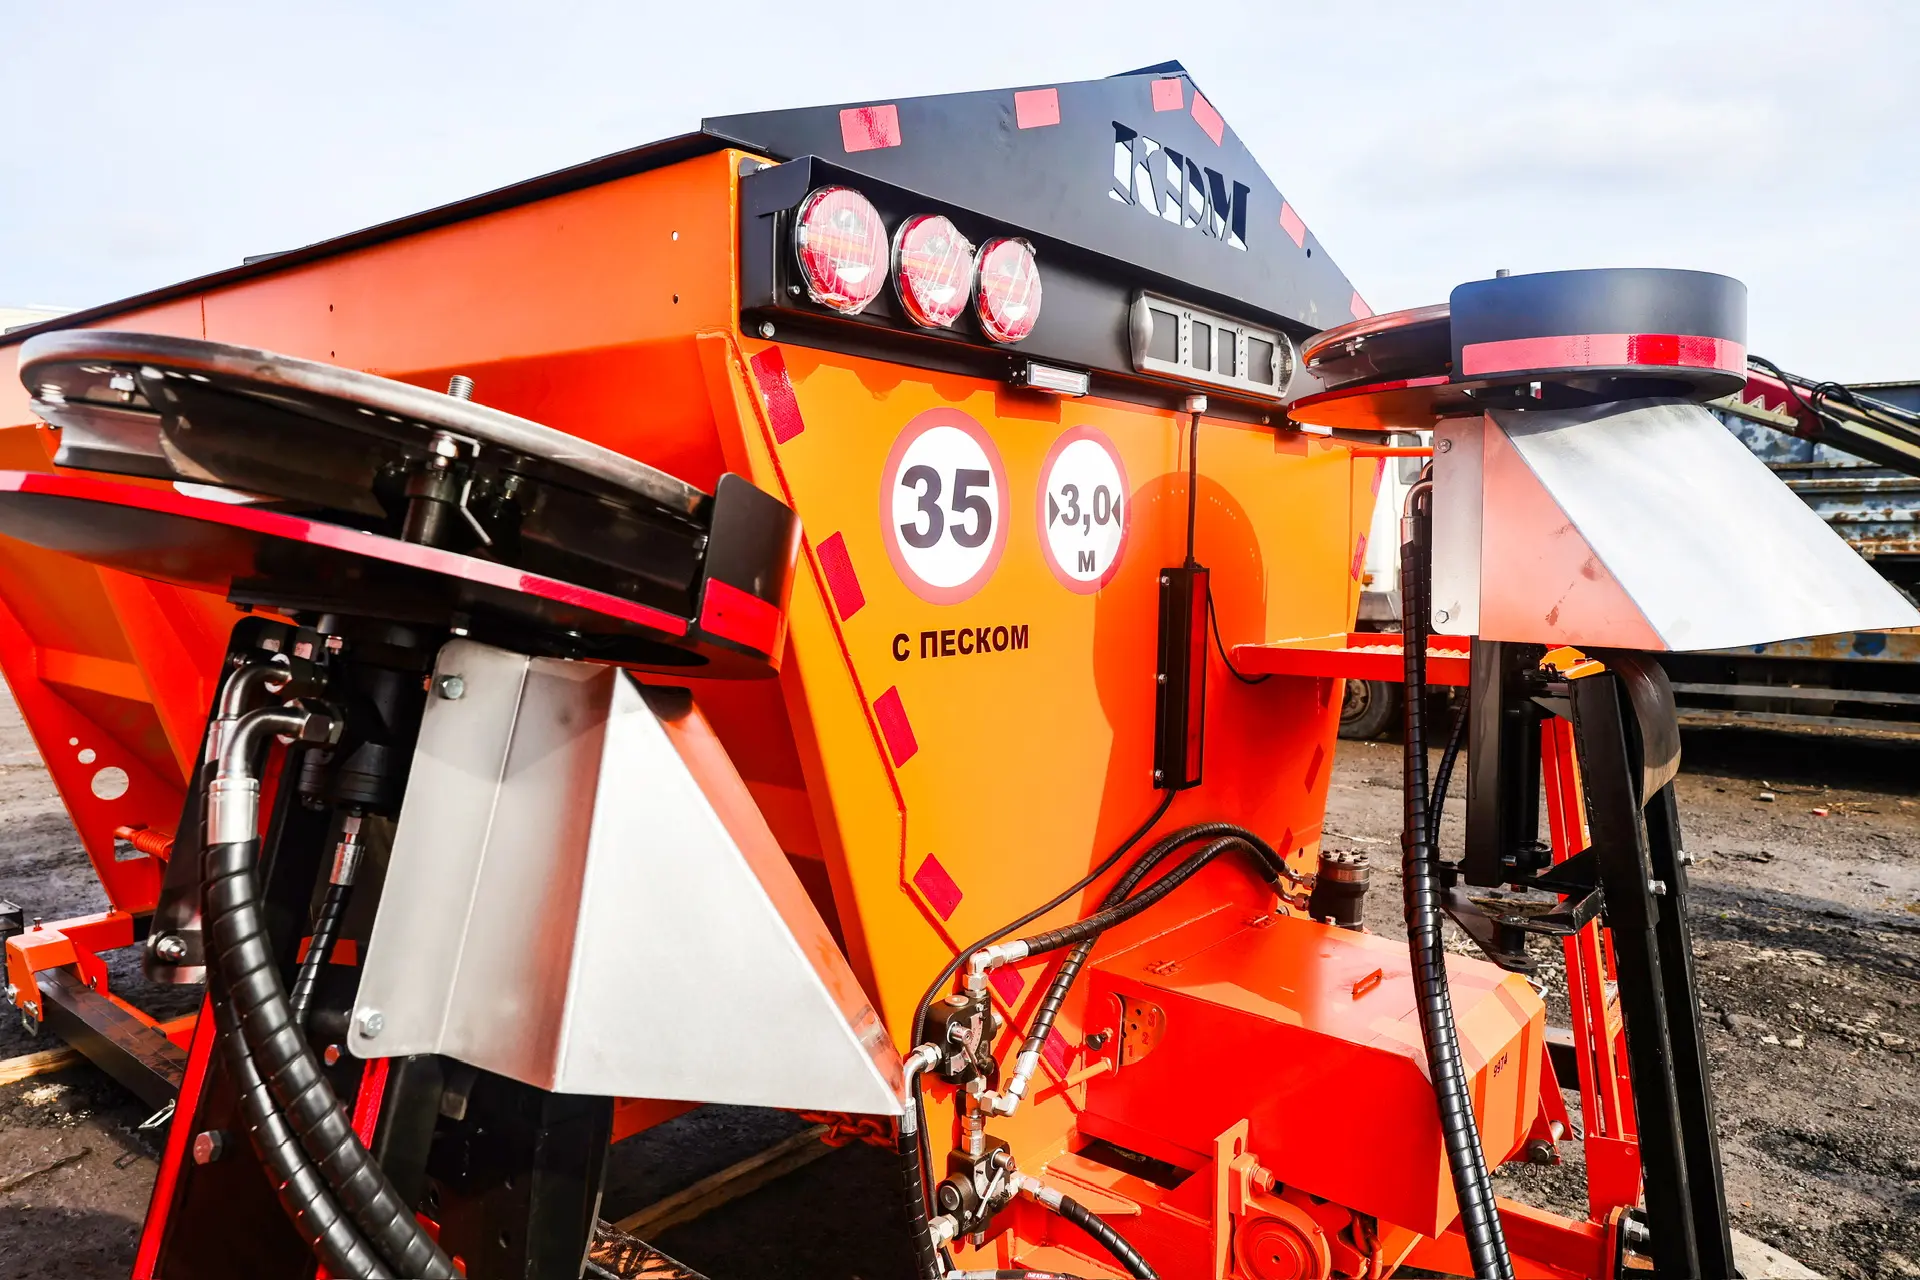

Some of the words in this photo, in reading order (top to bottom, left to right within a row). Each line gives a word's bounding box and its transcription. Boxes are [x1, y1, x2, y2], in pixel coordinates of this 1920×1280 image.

[1108, 120, 1251, 252] KDM
[900, 464, 993, 549] 35
[1060, 483, 1112, 536] 3,0
[892, 633, 911, 662] С
[920, 624, 1029, 659] ПЕСКОМ
